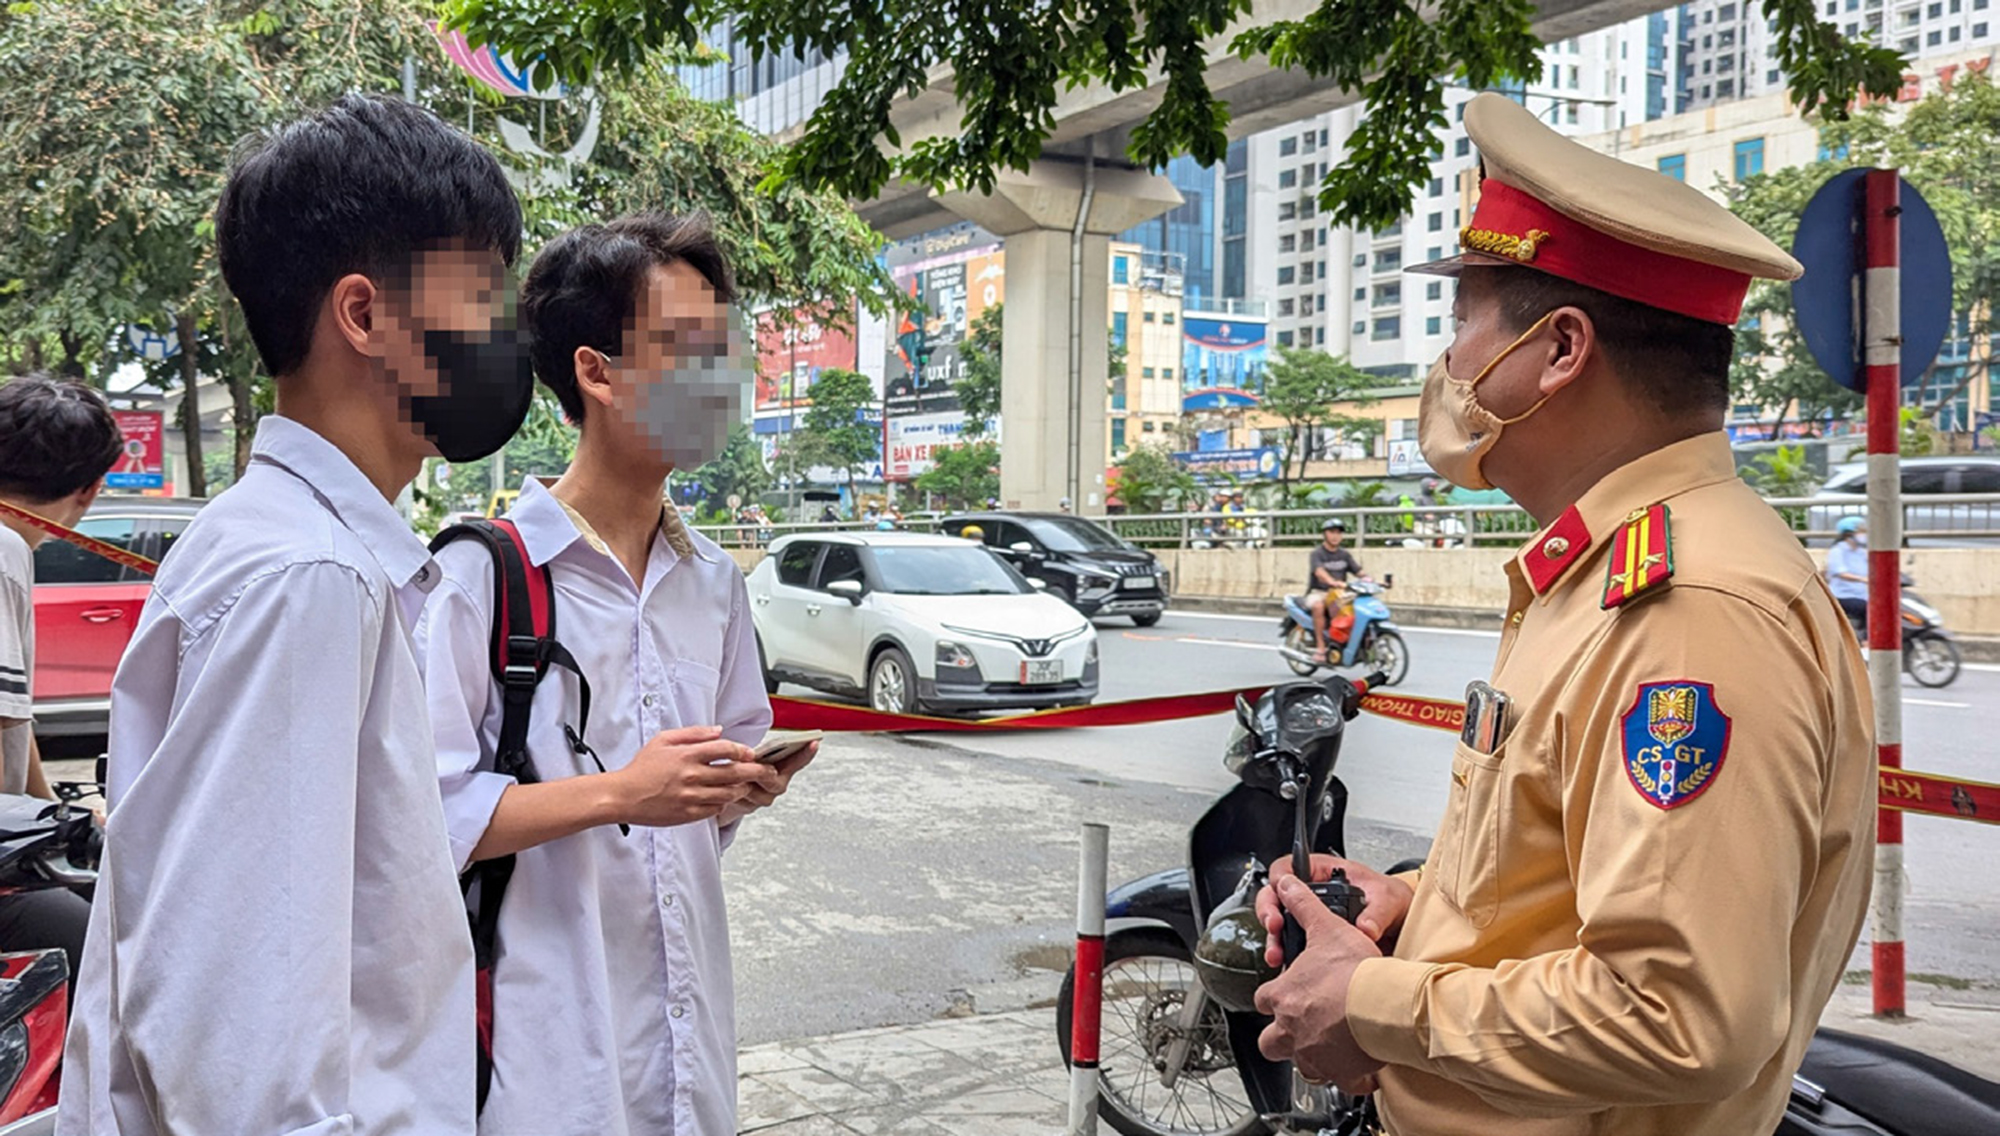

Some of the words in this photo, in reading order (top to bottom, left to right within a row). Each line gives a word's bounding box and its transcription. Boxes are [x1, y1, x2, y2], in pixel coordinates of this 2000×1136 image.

[915, 444, 927, 461] XE
[1420, 705, 1464, 725] GIAO
[1637, 745, 1663, 764] CS
[1675, 745, 1705, 765] GT
